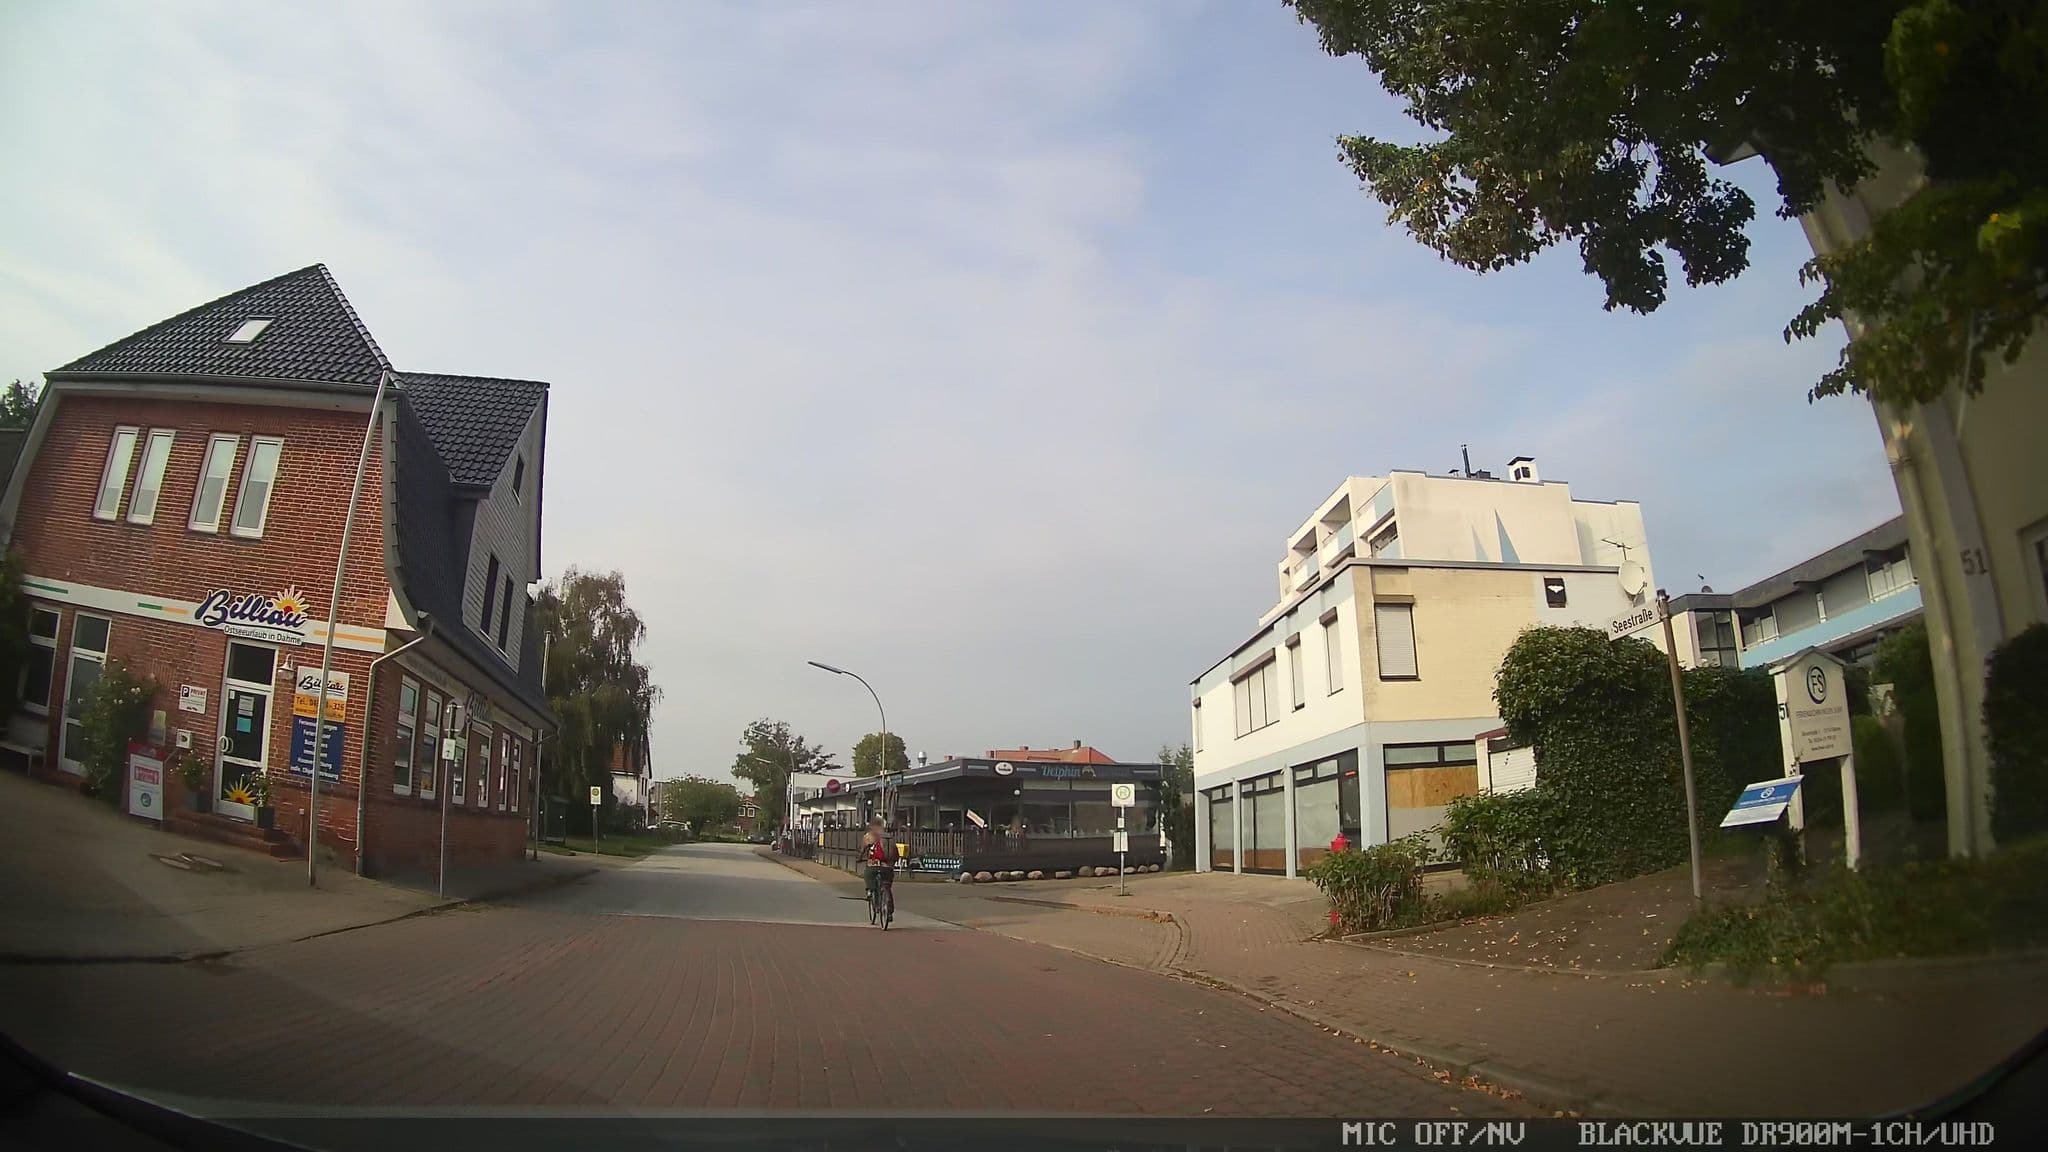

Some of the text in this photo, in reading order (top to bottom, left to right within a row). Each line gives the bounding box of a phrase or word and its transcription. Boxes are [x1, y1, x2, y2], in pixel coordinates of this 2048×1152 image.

[1961, 547, 1988, 575] 51
[195, 590, 308, 627] Billiau
[1612, 608, 1653, 634] Seestraße
[224, 625, 267, 639] Ostseeurlaub
[276, 633, 302, 645] Dahme
[1041, 765, 1080, 780] Delphin
